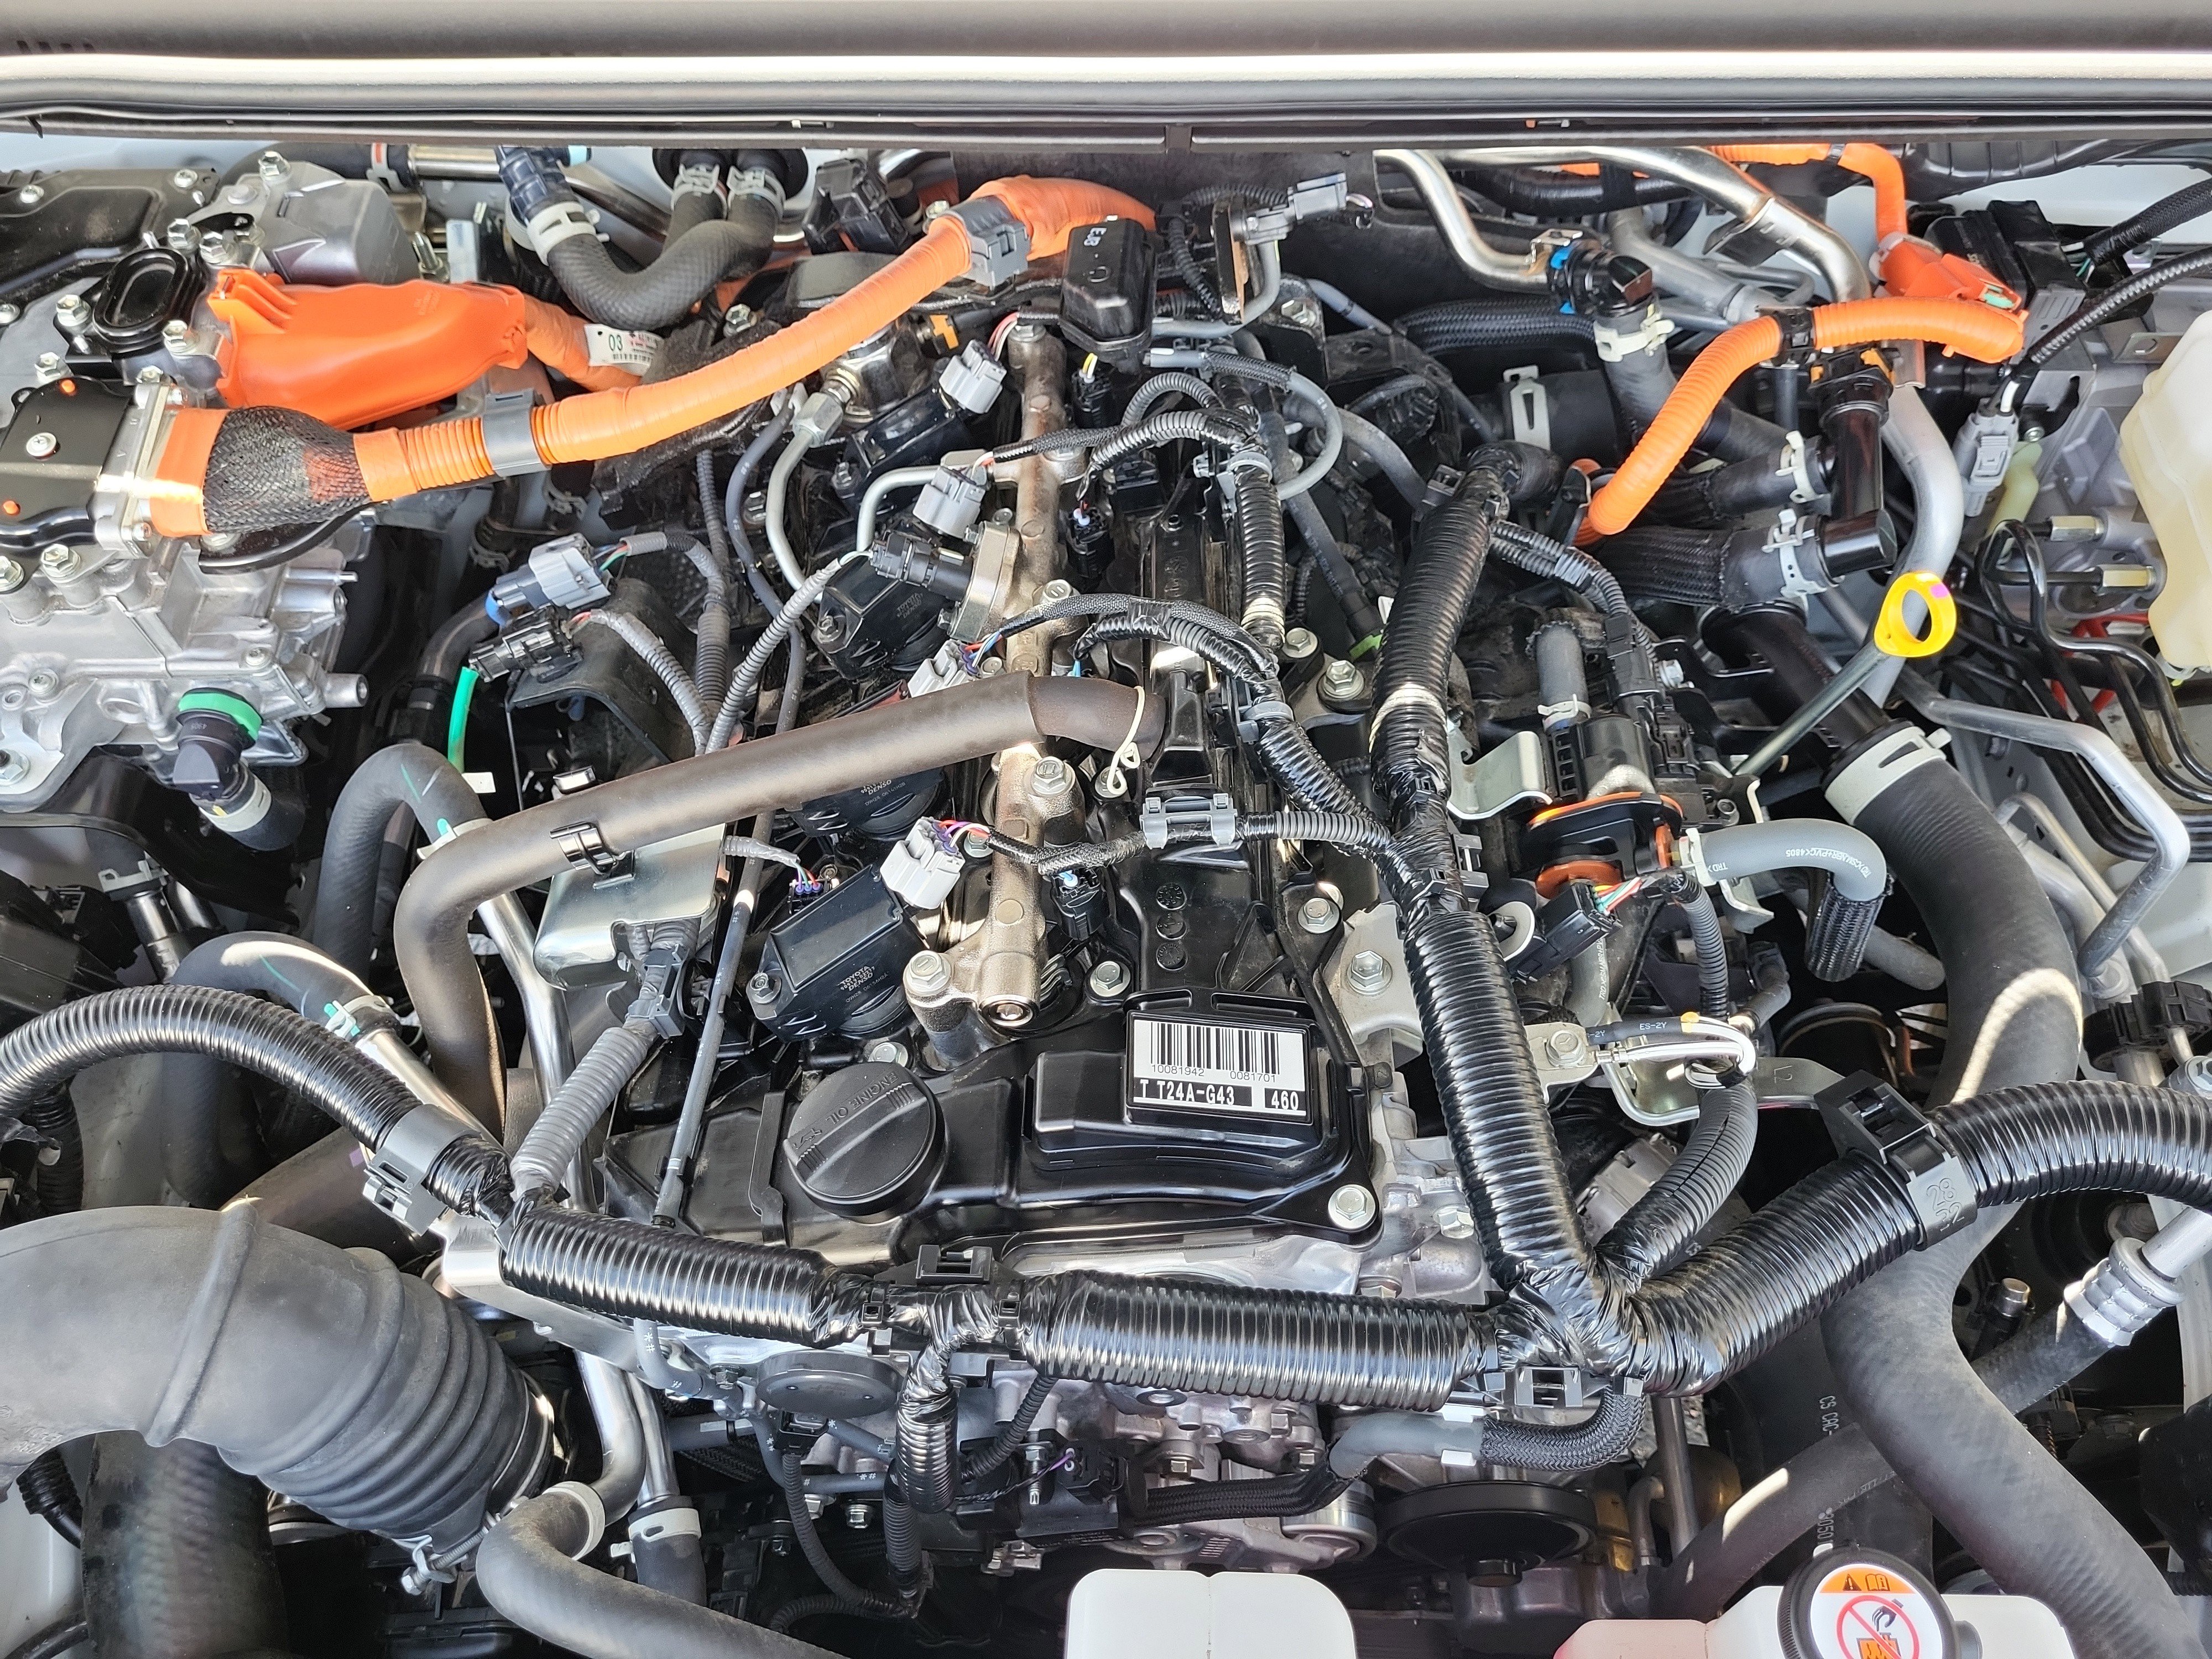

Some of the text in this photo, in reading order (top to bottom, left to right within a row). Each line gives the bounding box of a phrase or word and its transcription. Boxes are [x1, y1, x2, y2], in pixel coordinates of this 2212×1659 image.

[609, 334, 623, 351] 03
[868, 779, 892, 795] DENSO
[839, 966, 870, 985] TOYOTA
[848, 972, 873, 992] DENSO
[1639, 1021, 1667, 1030] ES-2Y
[1151, 1063, 1276, 1083] 10081942 0081701
[825, 1072, 899, 1124] ENGINE OIL
[1140, 1079, 1299, 1110] T T24A-G43 460
[1926, 1177, 1957, 1211] 28
[1819, 1395, 1837, 1410] CS
